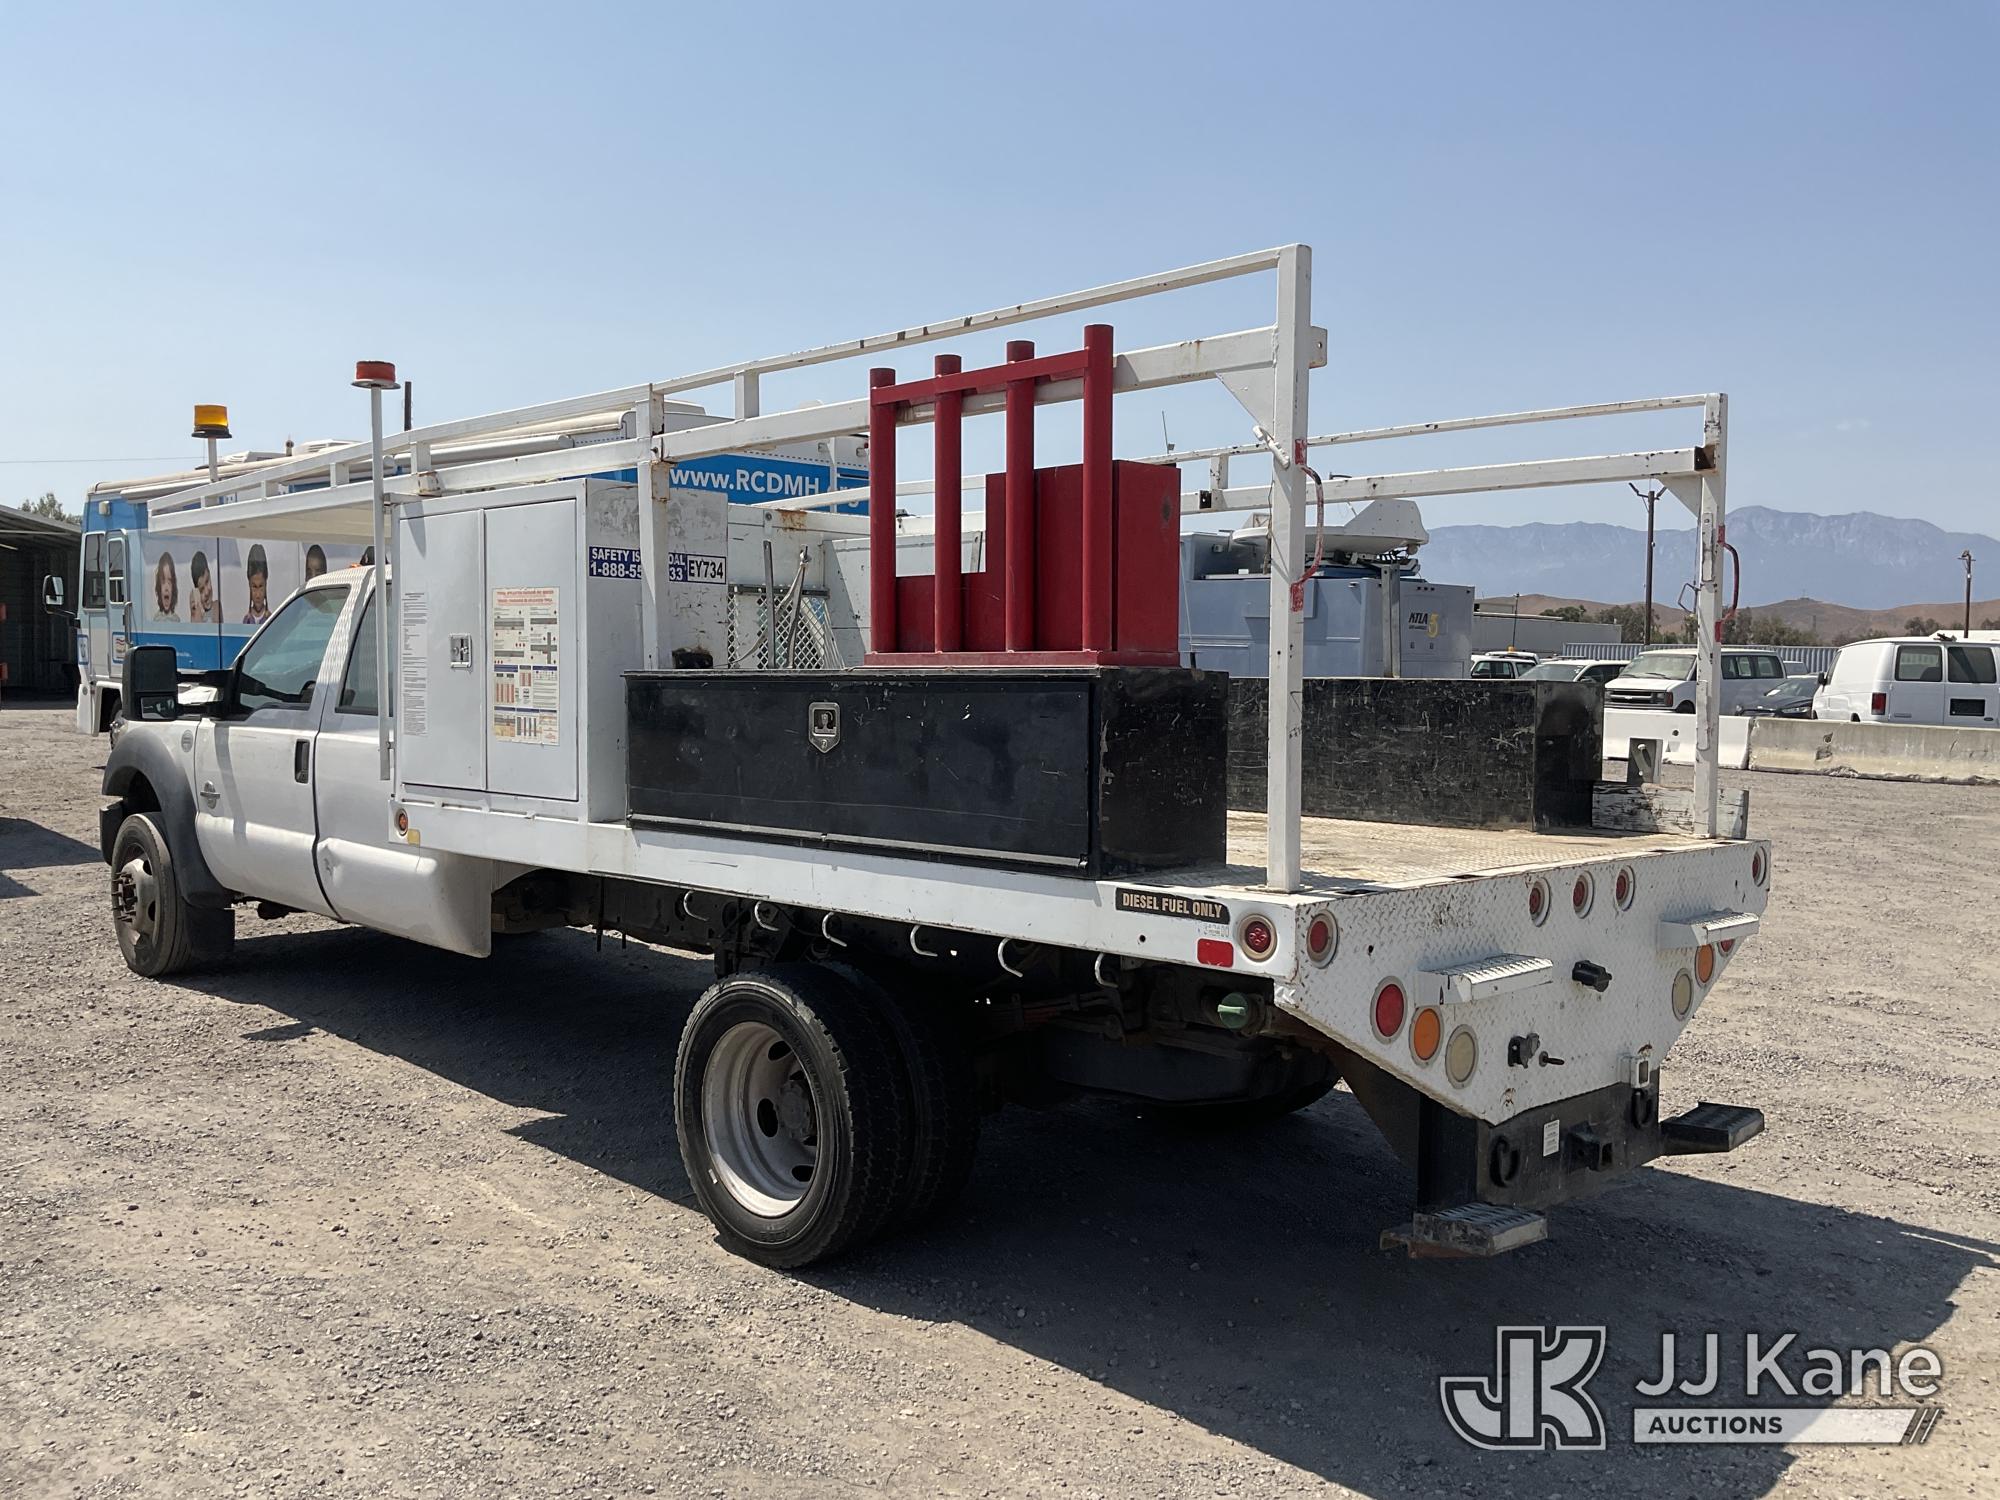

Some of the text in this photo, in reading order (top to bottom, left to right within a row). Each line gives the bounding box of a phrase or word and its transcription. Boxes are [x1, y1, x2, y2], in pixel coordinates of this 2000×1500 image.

[592, 547, 630, 562] SAFETY
[632, 550, 641, 563] IS
[688, 559, 724, 579] EY734
[1408, 612, 1428, 625] KTLA
[1122, 892, 1223, 918] DIESEL FUEL ONLY
